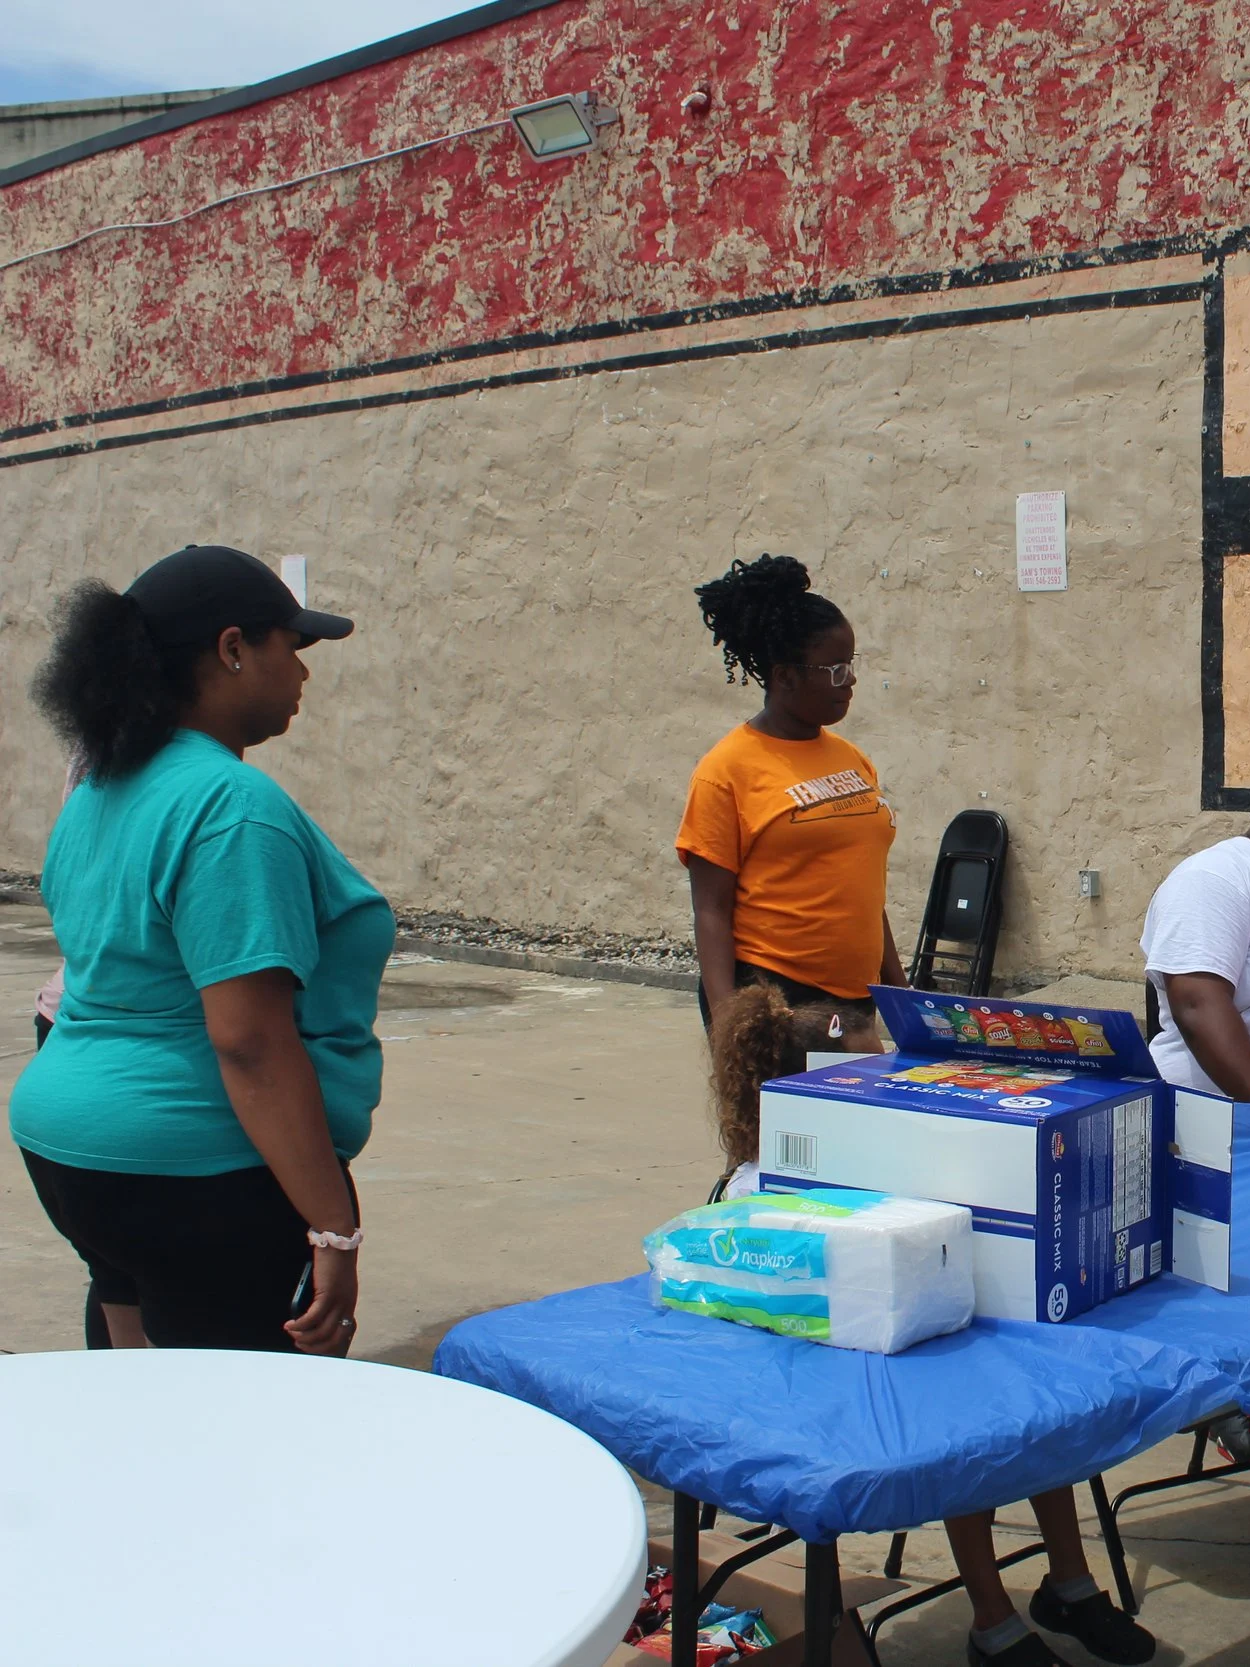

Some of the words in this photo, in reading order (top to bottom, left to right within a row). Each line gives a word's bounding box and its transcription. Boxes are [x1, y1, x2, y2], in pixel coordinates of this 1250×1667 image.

[1021, 568, 1037, 576] SAM'S
[1039, 567, 1062, 575] TOWING
[873, 1082, 953, 1098] CLASSIC
[951, 1092, 990, 1101] MIX
[1053, 1172, 1062, 1239] CLASSIC
[742, 1251, 796, 1269] napkins
[1053, 1243, 1061, 1271] MIX
[1053, 1288, 1064, 1317] 50
[780, 1318, 807, 1332] 500
